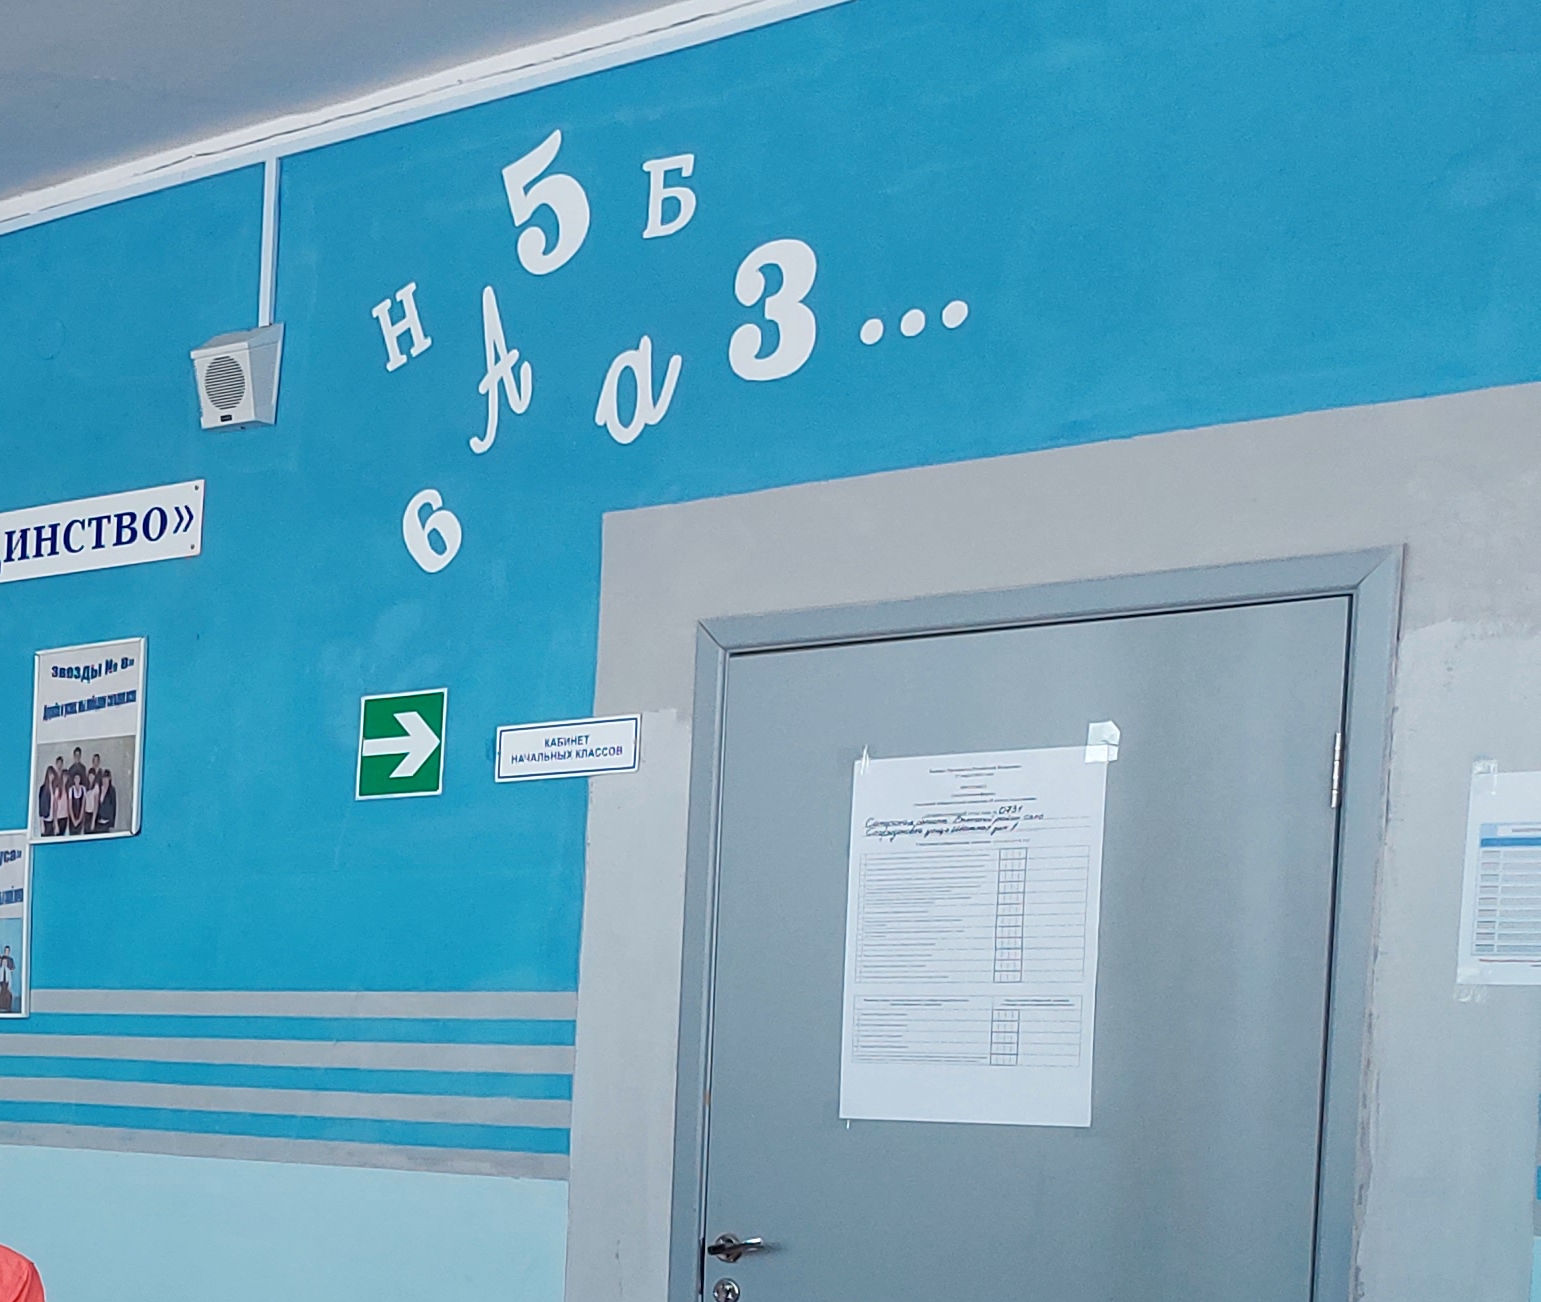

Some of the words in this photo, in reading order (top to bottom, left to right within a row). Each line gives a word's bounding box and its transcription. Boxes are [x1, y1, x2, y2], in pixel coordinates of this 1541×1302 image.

[502, 129, 590, 275] 5
[642, 153, 697, 239] Б
[402, 488, 463, 573] 6
[511, 750, 573, 765] НАЧАЛЬНЫХ
[575, 746, 623, 760] КЛАССОВ
[544, 735, 591, 748] КАБИНЕТ
